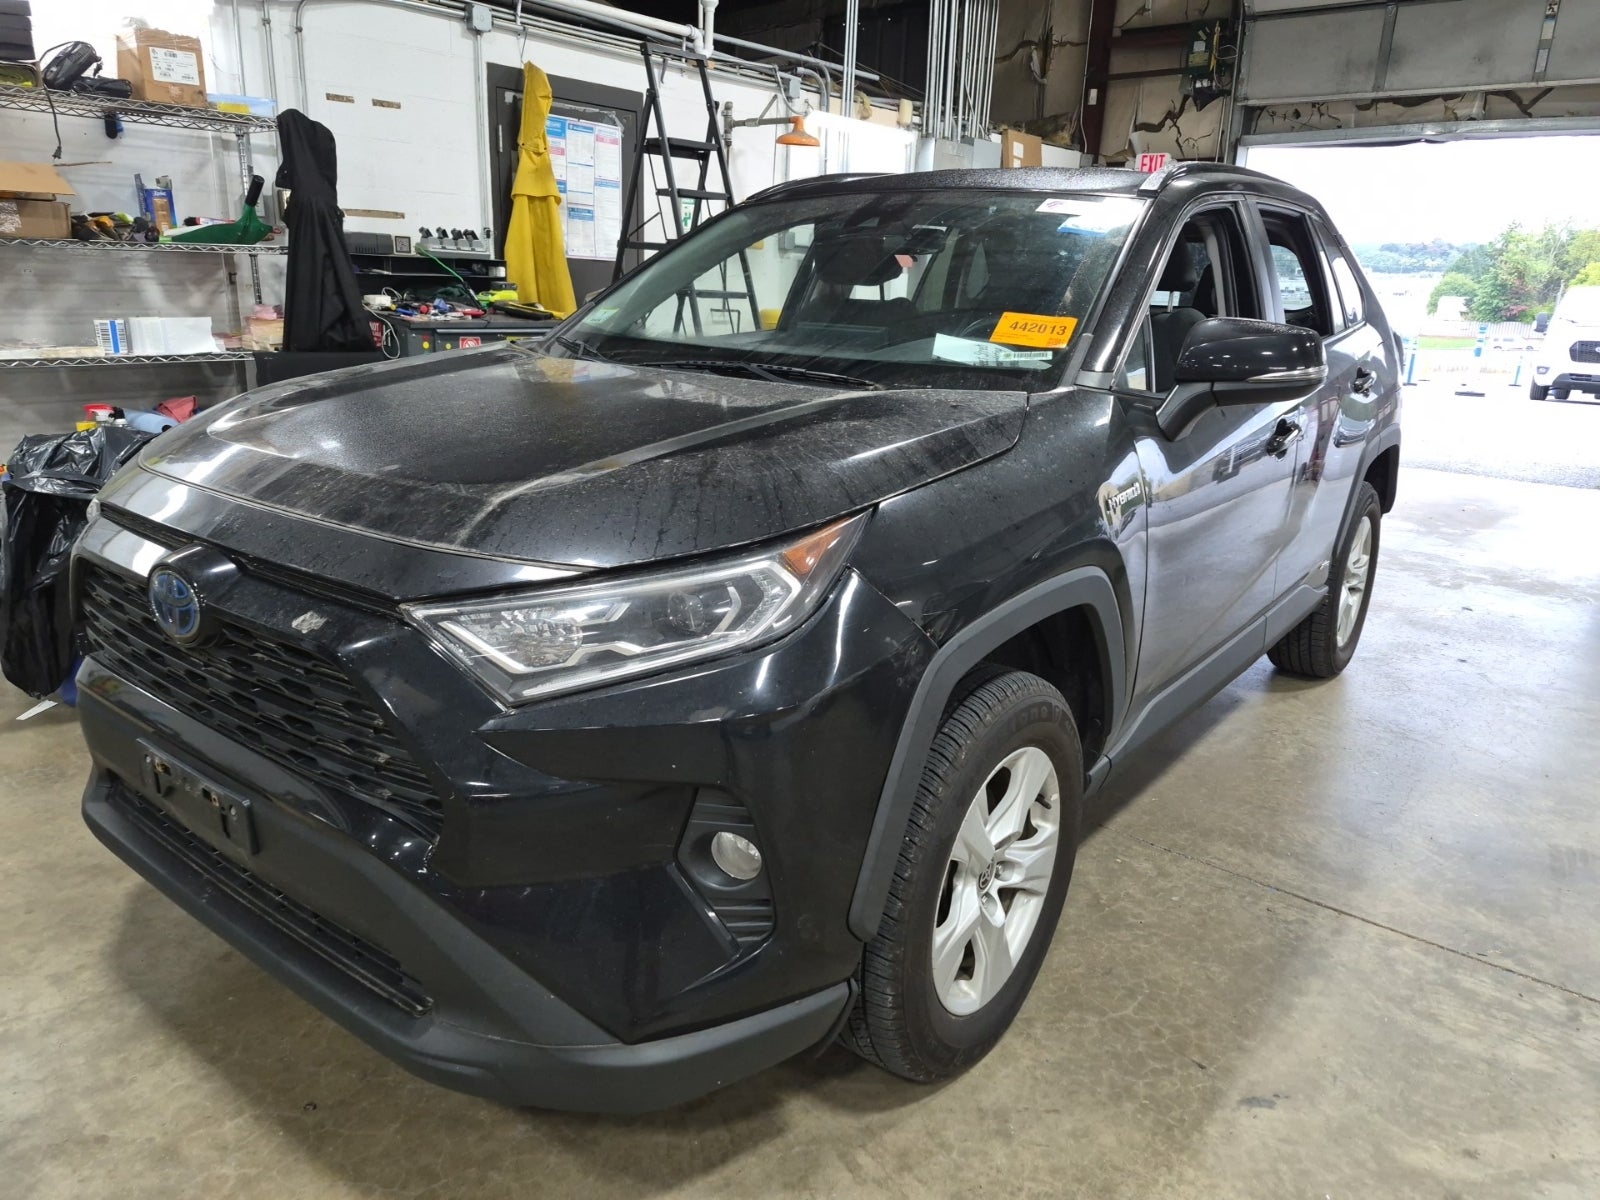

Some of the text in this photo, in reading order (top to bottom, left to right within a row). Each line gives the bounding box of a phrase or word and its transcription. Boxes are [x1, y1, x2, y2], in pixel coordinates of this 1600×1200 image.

[1140, 154, 1166, 173] EXIT
[1009, 321, 1067, 336] 442013
[1108, 482, 1141, 509] HYBRID
